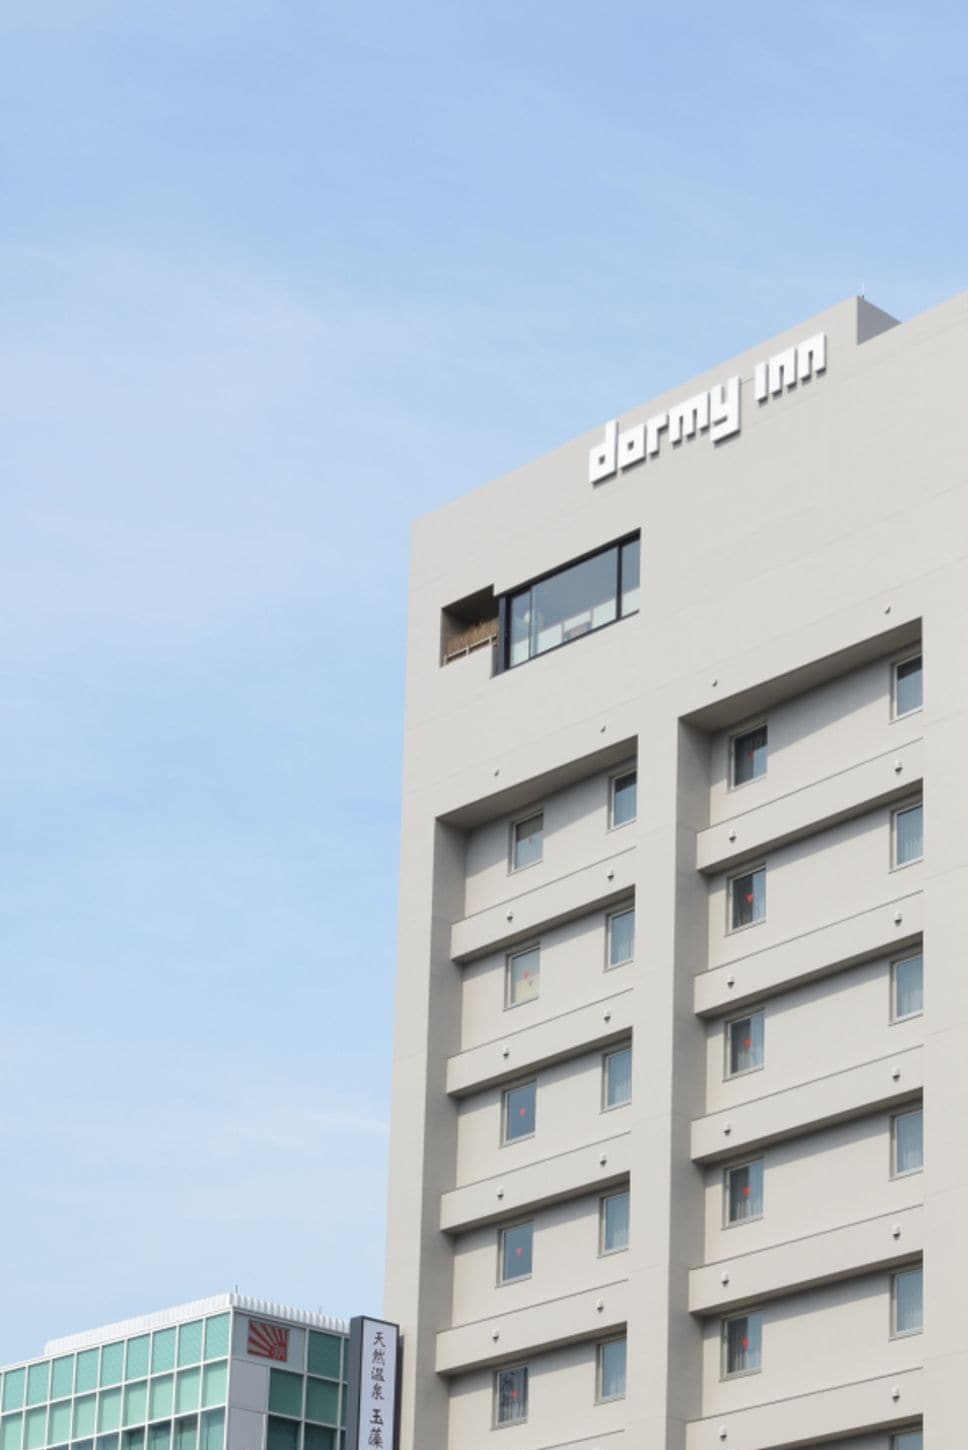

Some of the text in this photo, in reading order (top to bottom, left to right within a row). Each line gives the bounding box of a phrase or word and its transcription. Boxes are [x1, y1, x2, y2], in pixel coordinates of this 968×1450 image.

[589, 332, 826, 484] dormy inn
[371, 1331, 386, 1400] 天然温泉
